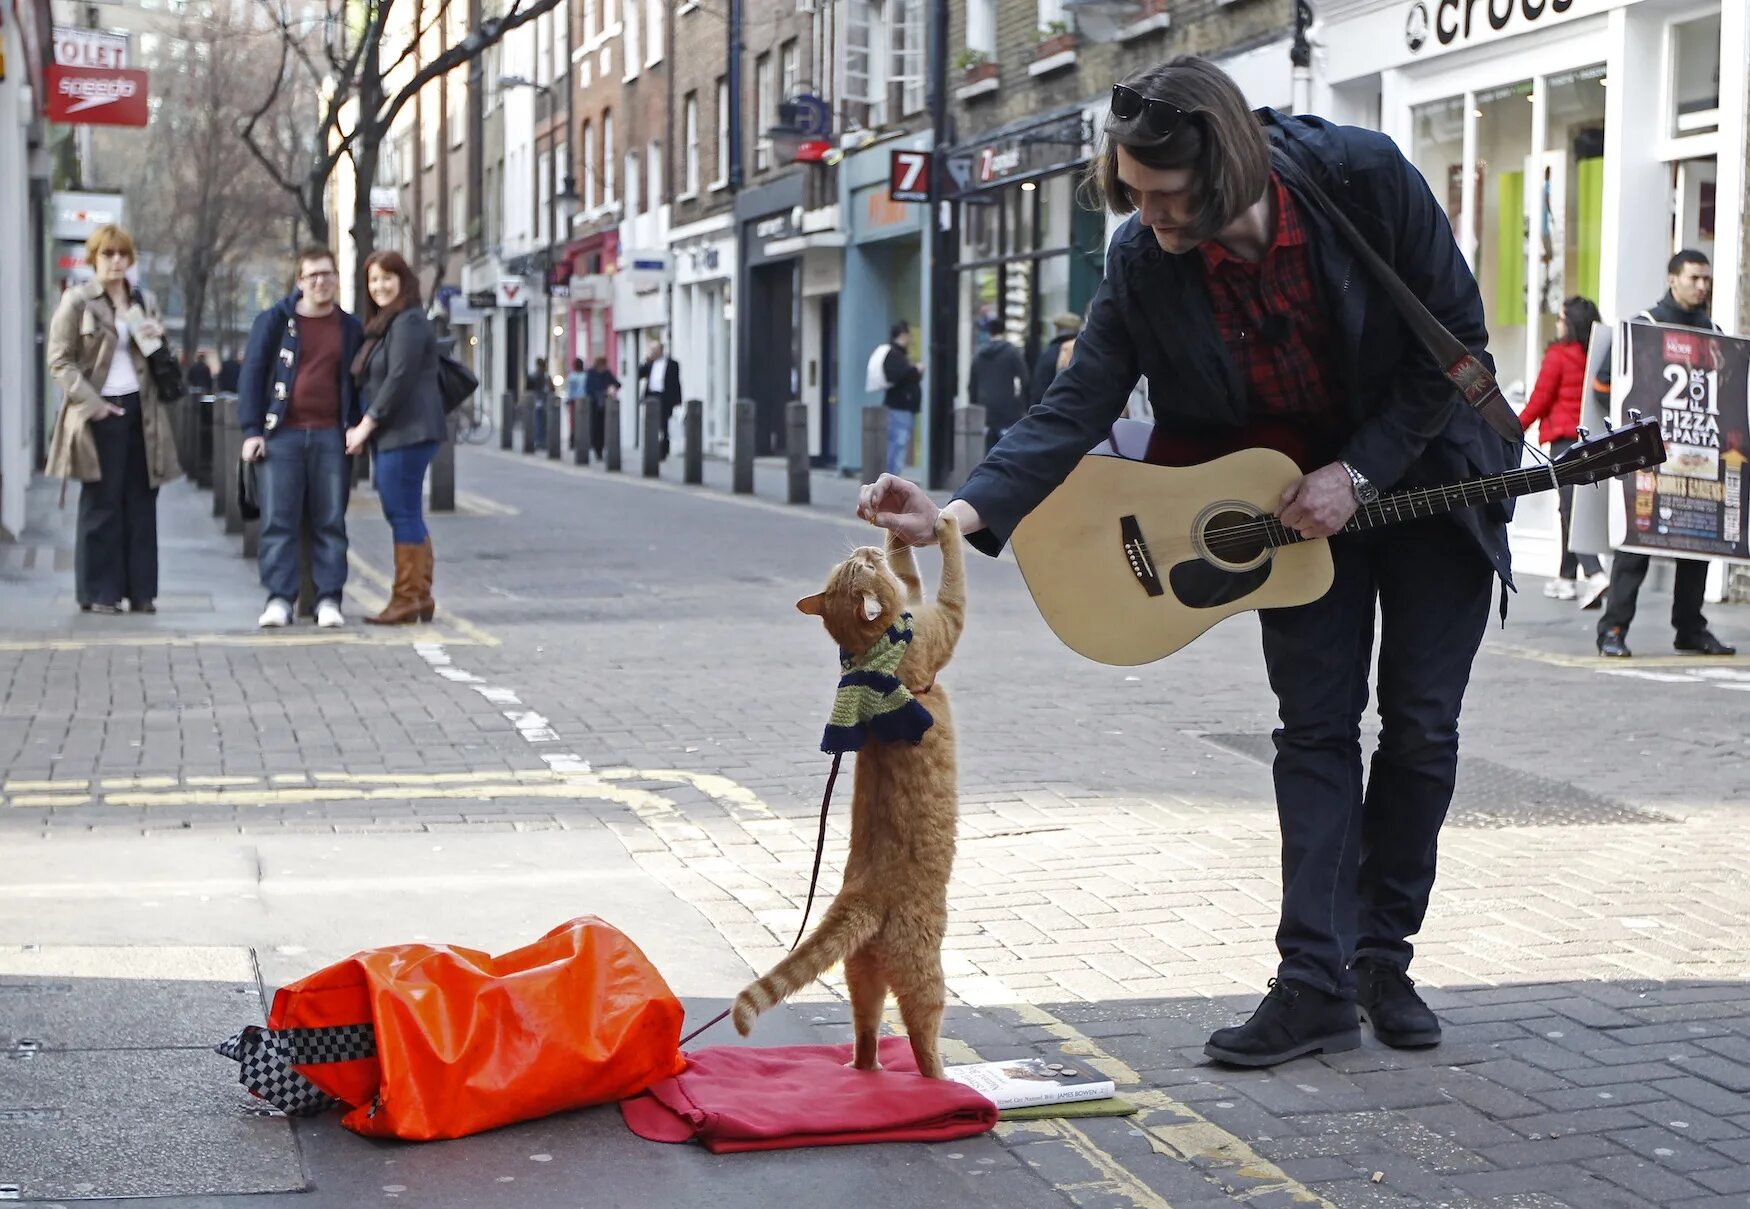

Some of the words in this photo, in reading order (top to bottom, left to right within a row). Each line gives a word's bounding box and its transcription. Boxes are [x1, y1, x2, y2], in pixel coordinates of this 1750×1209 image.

[58, 75, 136, 97] speedo
[898, 153, 925, 191] 7
[1662, 364, 1688, 410] 2
[1690, 368, 1705, 413] FOR
[1706, 370, 1720, 415] 1
[1662, 409, 1720, 434] PIZZA
[1673, 428, 1720, 448] PASTA
[1057, 1092, 1074, 1100] JAMES
